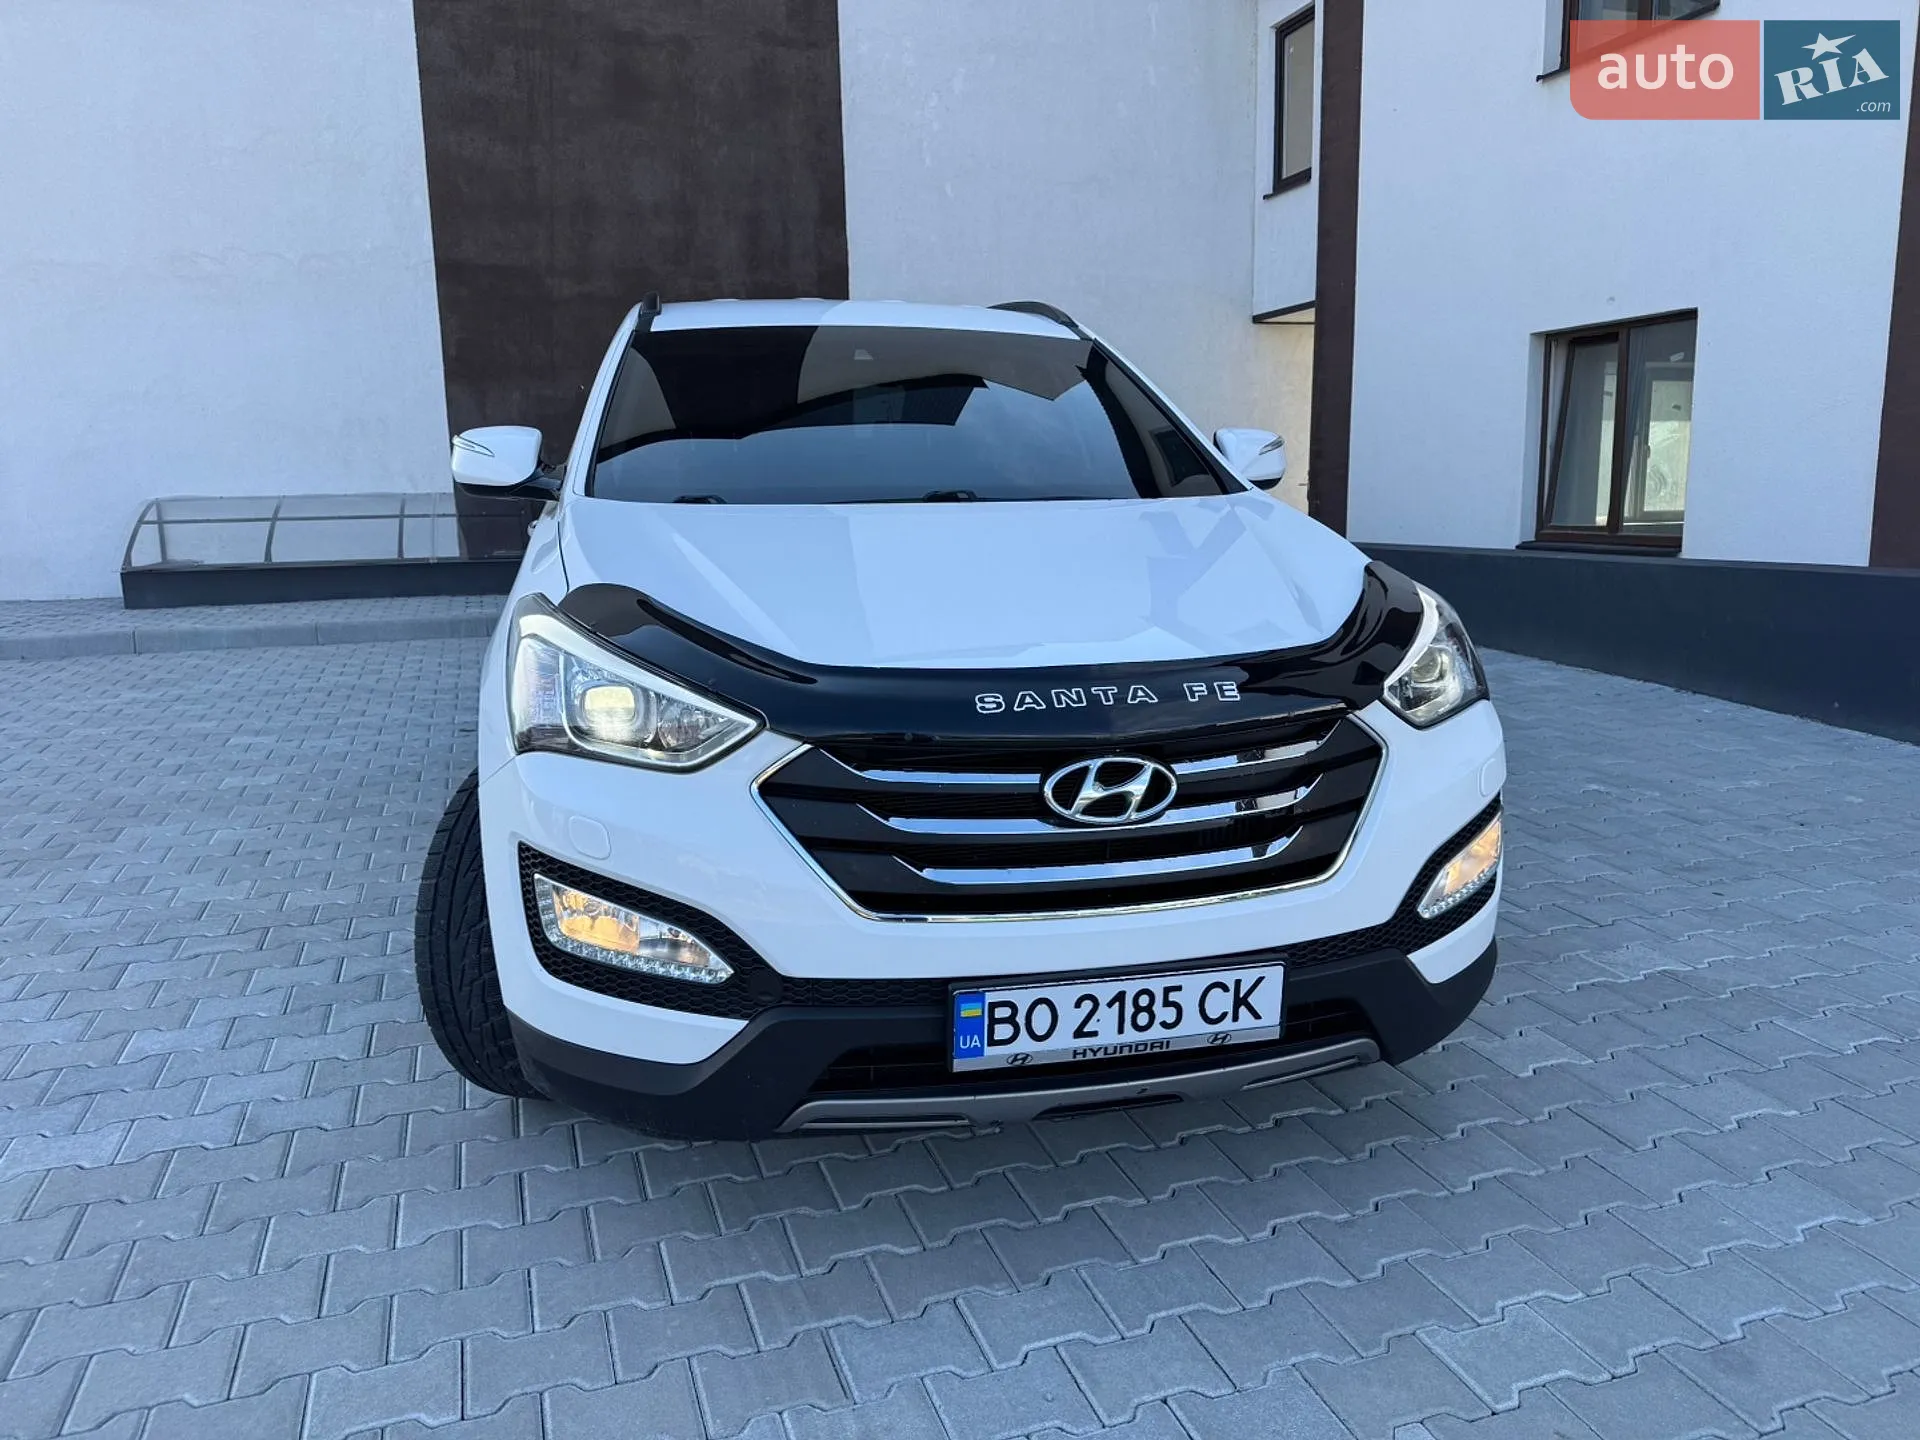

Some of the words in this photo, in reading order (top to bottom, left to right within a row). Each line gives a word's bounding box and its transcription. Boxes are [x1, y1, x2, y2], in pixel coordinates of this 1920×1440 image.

[975, 685, 1159, 714] SANTA
[1183, 681, 1241, 702] FE
[987, 997, 1059, 1048] BO
[1072, 984, 1184, 1040] 2185
[1198, 975, 1266, 1026] CK
[960, 1035, 982, 1049] UA
[1072, 1039, 1171, 1060] HYUNDAI
